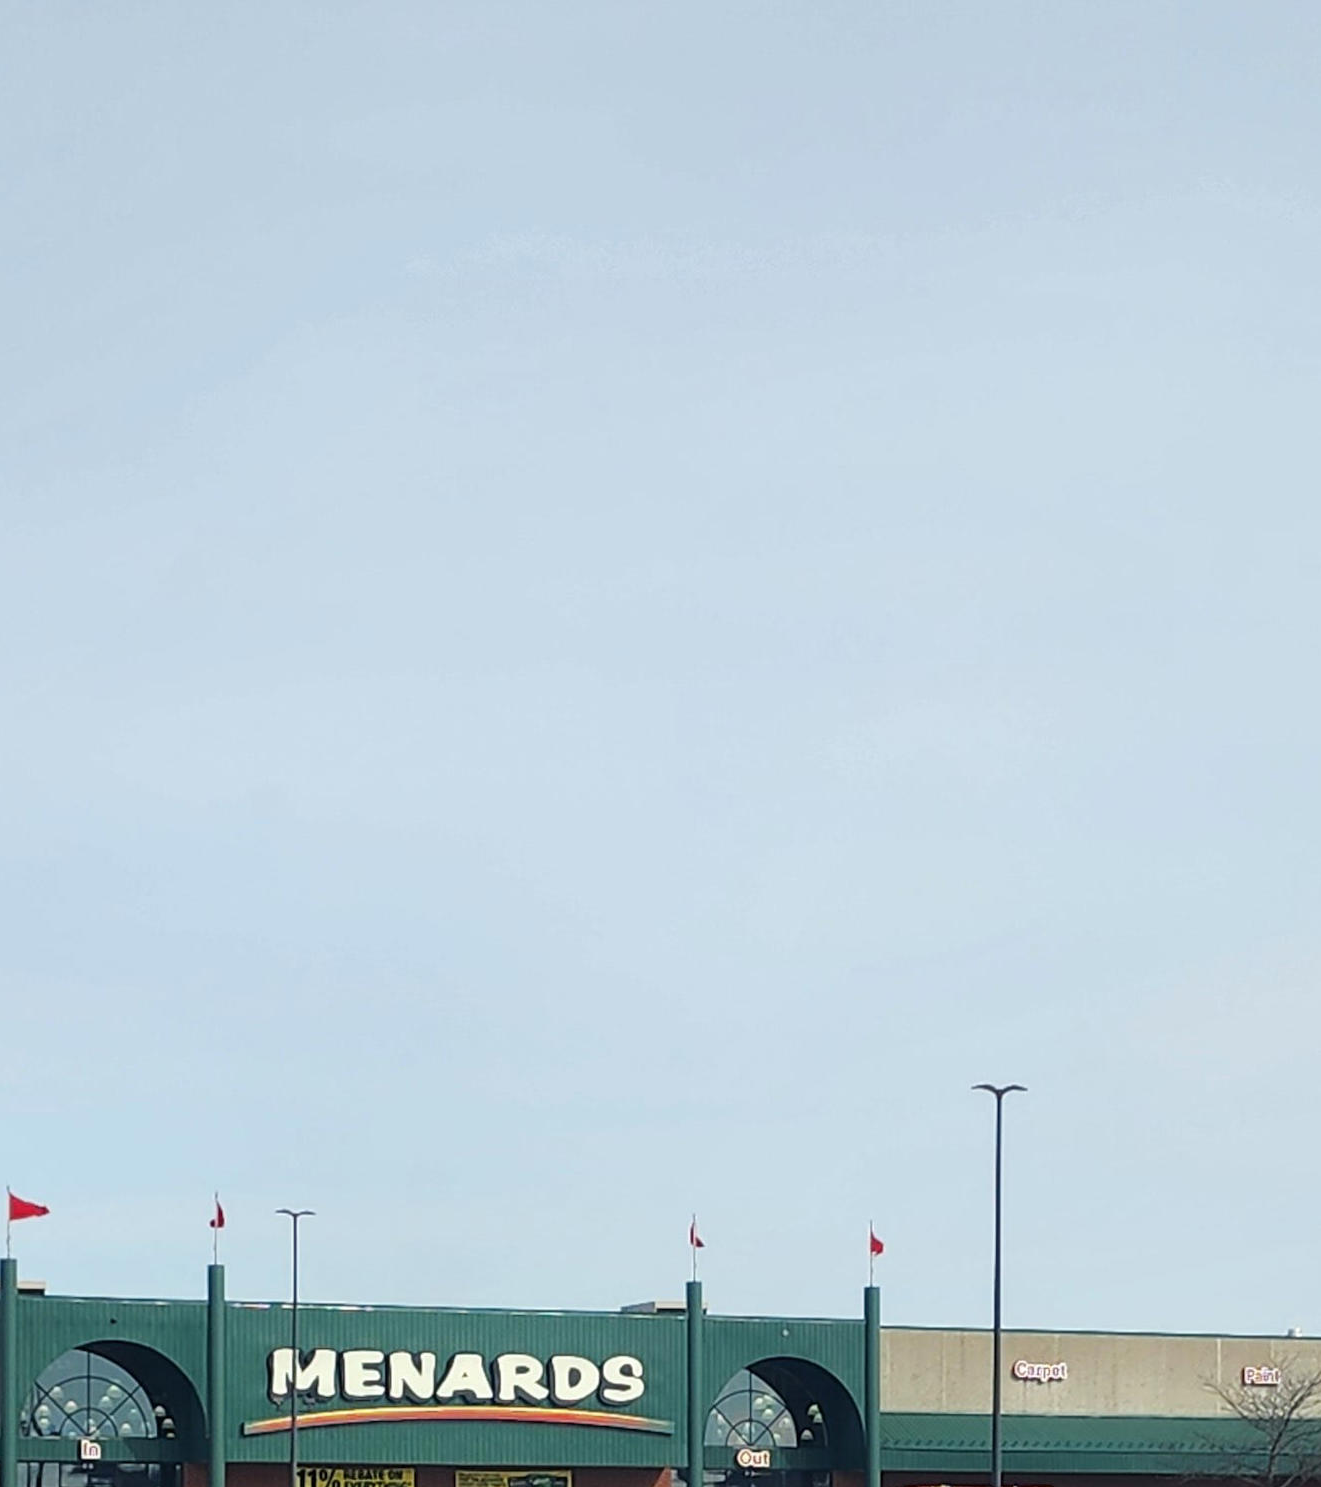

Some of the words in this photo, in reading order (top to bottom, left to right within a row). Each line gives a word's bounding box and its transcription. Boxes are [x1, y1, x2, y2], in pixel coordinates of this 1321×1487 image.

[270, 1347, 645, 1402] MENARDS
[80, 1439, 102, 1460] In
[736, 1448, 771, 1468] Out
